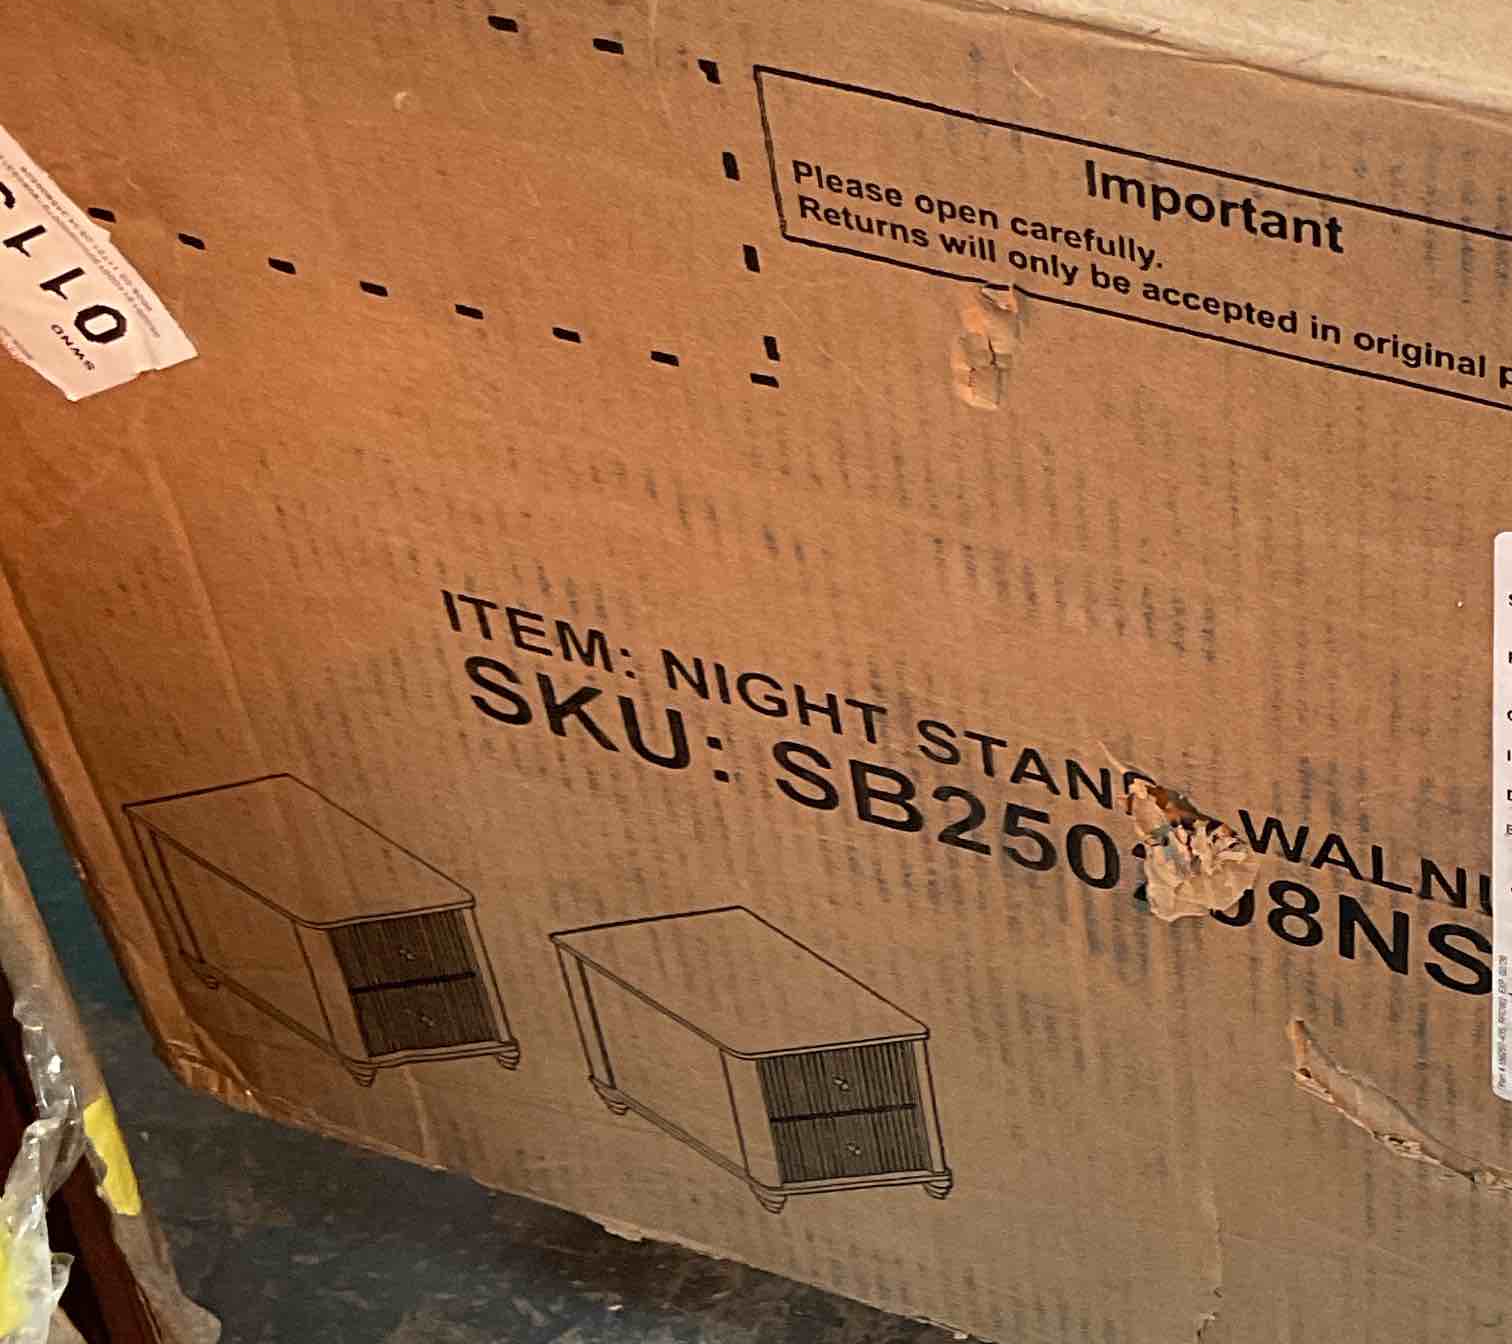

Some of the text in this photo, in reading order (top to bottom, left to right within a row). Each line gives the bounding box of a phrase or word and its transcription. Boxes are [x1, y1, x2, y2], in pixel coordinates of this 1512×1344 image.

[0, 180, 127, 344] 011
[792, 159, 1165, 271] Please open carefully.
[798, 194, 930, 248] Returns
[939, 233, 997, 263] will
[1008, 250, 1079, 286] only
[1091, 263, 1131, 295] be
[1141, 283, 1298, 335] accepted
[1311, 315, 1341, 345] in
[1352, 331, 1487, 379] original
[1086, 159, 1344, 254] Important
[441, 588, 636, 679] ITEM:
[660, 648, 889, 744] NIGHT
[464, 655, 1493, 996] SKU: SB2508NS
